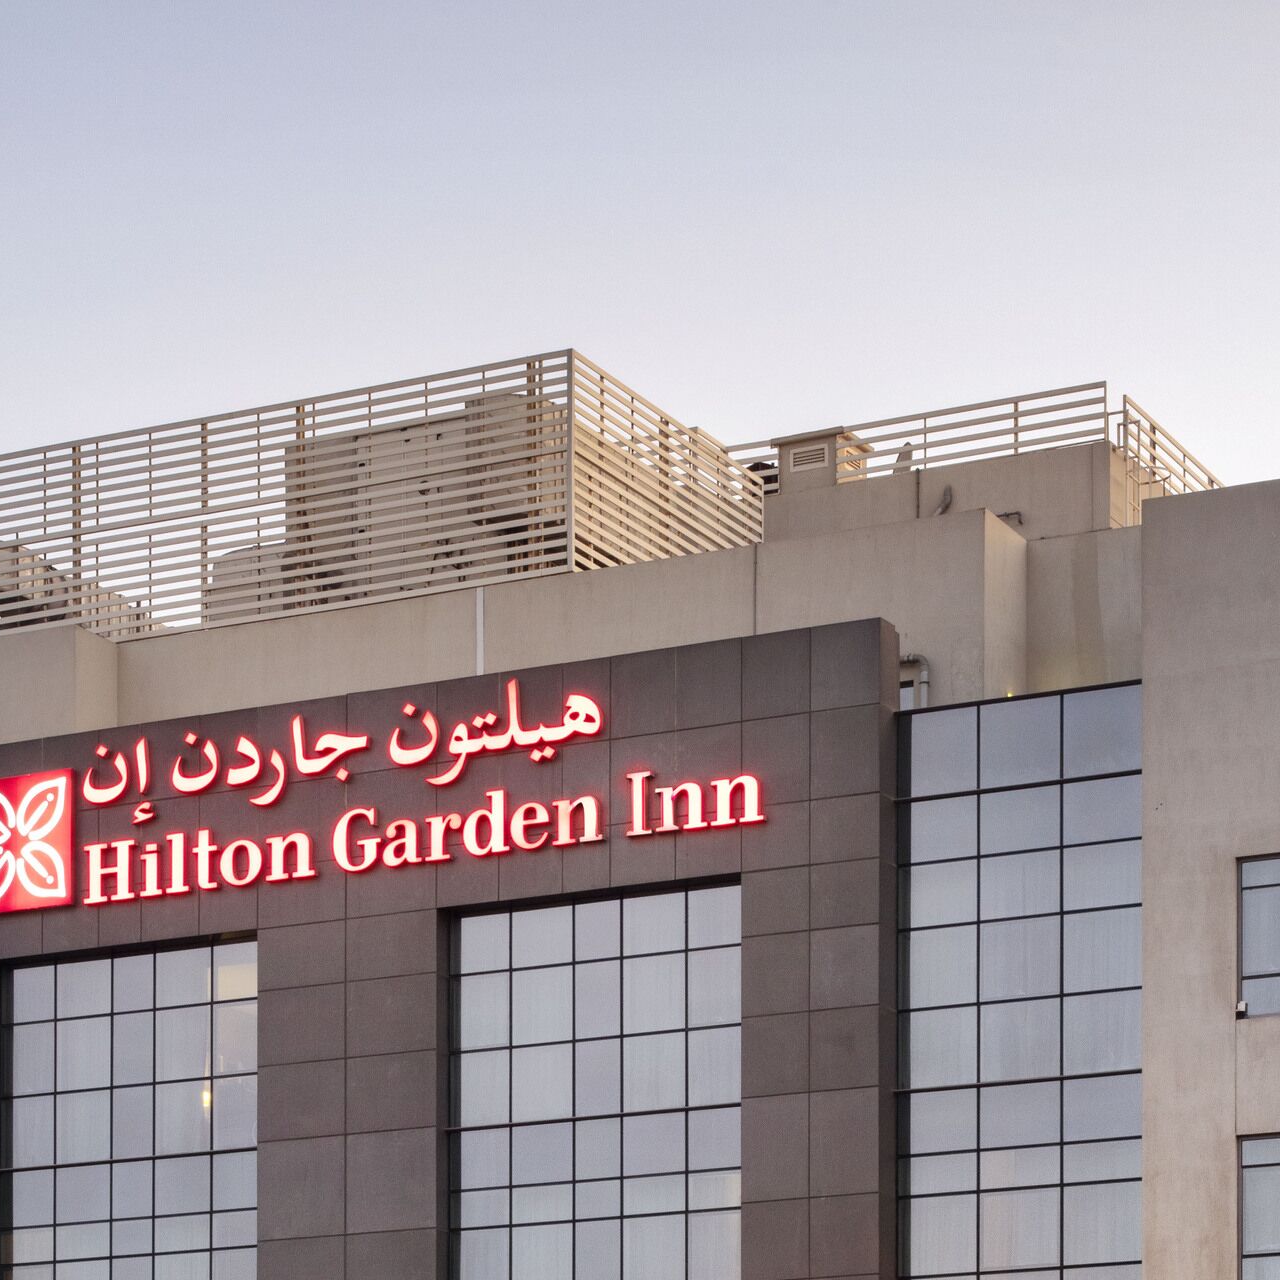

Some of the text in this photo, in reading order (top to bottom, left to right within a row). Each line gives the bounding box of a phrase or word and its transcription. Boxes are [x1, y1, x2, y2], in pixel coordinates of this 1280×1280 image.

[82, 680, 603, 824] هيلتون جاردن إن
[81, 770, 765, 905] Hilton Garden Inn
